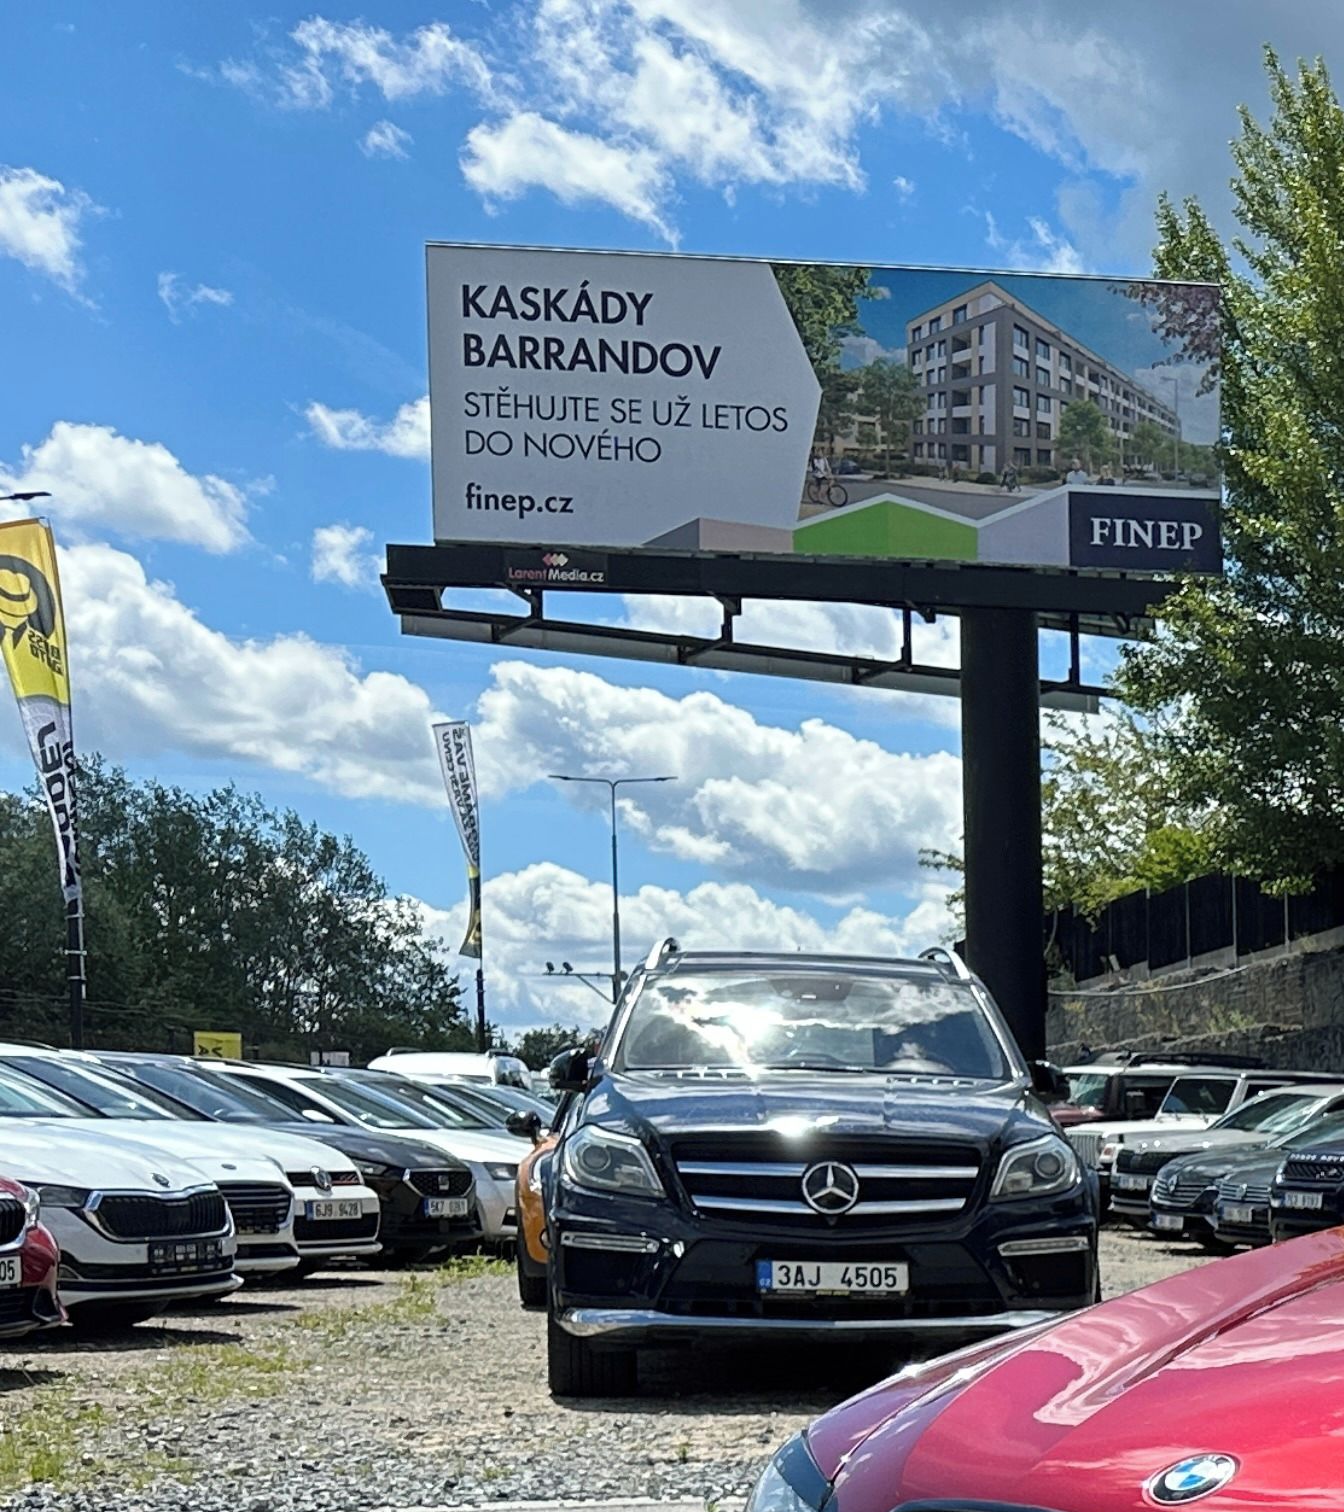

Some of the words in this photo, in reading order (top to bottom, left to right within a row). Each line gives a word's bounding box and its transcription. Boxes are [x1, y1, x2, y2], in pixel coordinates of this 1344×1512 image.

[461, 279, 654, 326] KASKÁDY
[463, 333, 722, 379] BARRANDOV
[464, 386, 600, 422] STĚHUJTE
[610, 398, 642, 424] SE
[653, 395, 692, 427] UŽ
[702, 403, 789, 432] LETOS
[465, 430, 513, 456] DO
[524, 429, 661, 463] NOVÉHO
[466, 482, 574, 519] finep.cz
[1090, 517, 1202, 550] FINEP
[778, 1265, 820, 1286] 3AJ
[841, 1266, 897, 1288] 4505
